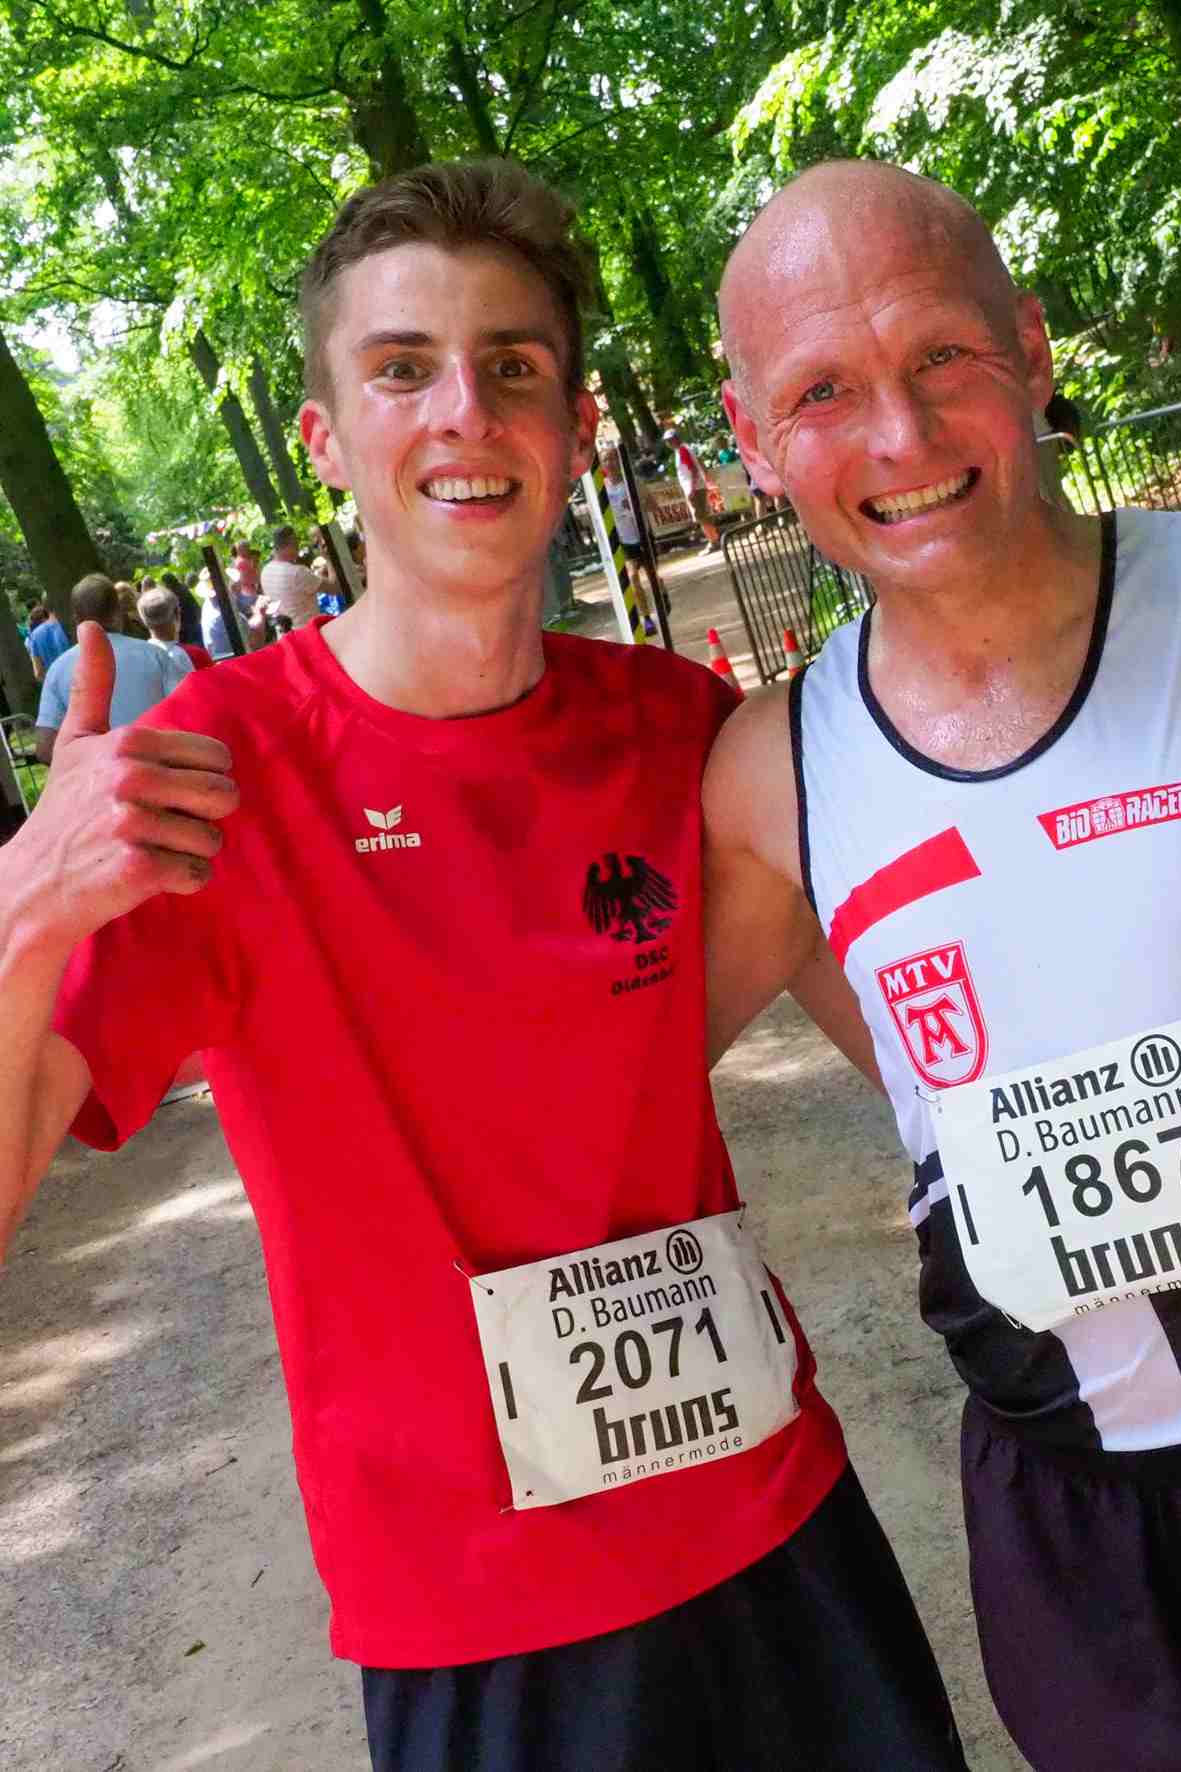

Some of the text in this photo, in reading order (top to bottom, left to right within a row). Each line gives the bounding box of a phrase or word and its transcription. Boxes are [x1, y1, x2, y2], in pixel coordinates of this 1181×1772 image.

[355, 829, 422, 853] erima
[882, 951, 959, 1000] MTV
[990, 1062, 1125, 1123] Allianz
[996, 1129, 1032, 1163] D.
[548, 1250, 663, 1303] Allianz
[552, 1274, 717, 1339] D. Baumann
[568, 1306, 728, 1405] 2071
[592, 1387, 740, 1466] bruns
[601, 1435, 744, 1486] männermode
